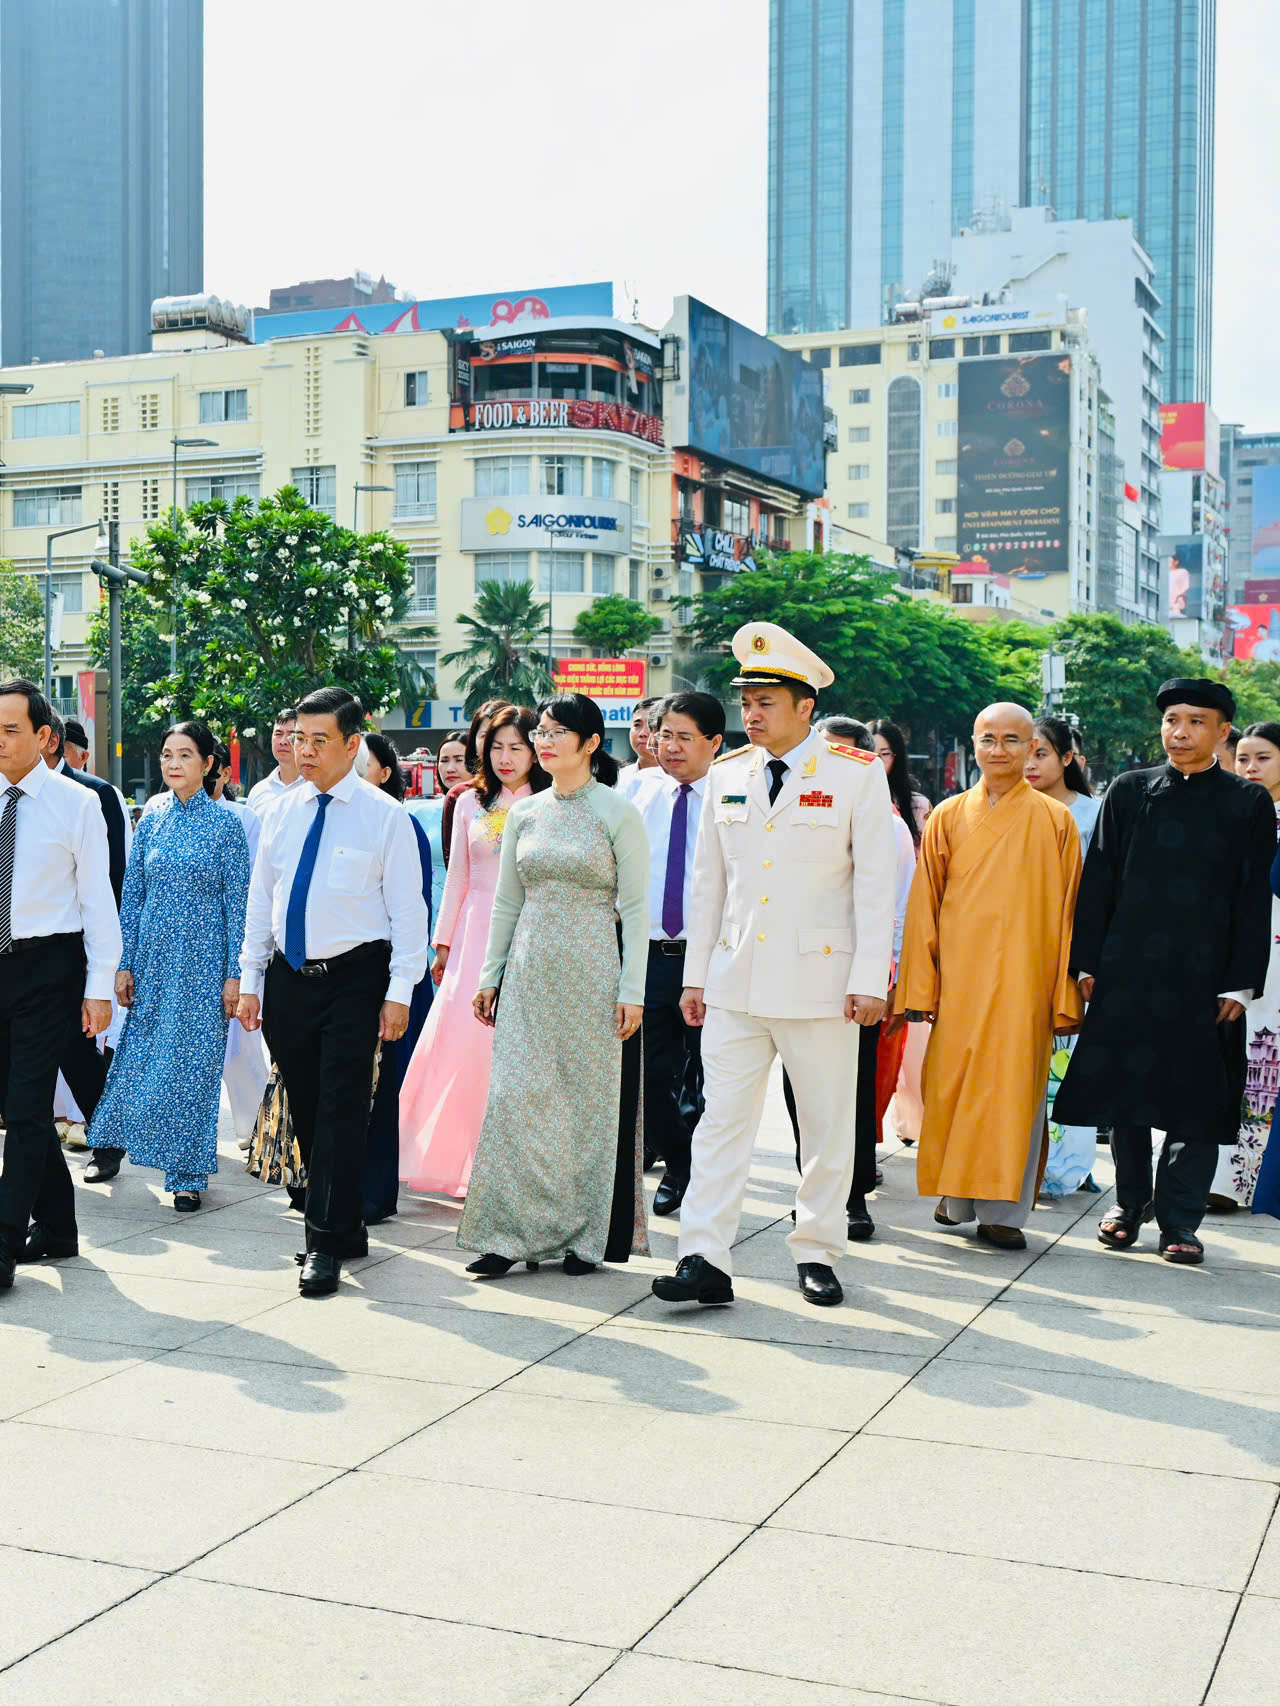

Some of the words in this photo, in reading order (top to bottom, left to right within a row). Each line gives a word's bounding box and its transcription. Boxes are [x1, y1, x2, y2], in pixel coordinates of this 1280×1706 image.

[501, 338, 536, 351] SAIGON
[474, 402, 513, 429] FOOD
[517, 406, 526, 425] &
[529, 401, 569, 427] BEER
[572, 400, 628, 434] SKY
[630, 409, 665, 445] ZONE
[518, 514, 617, 531] SAIGONTOURIST
